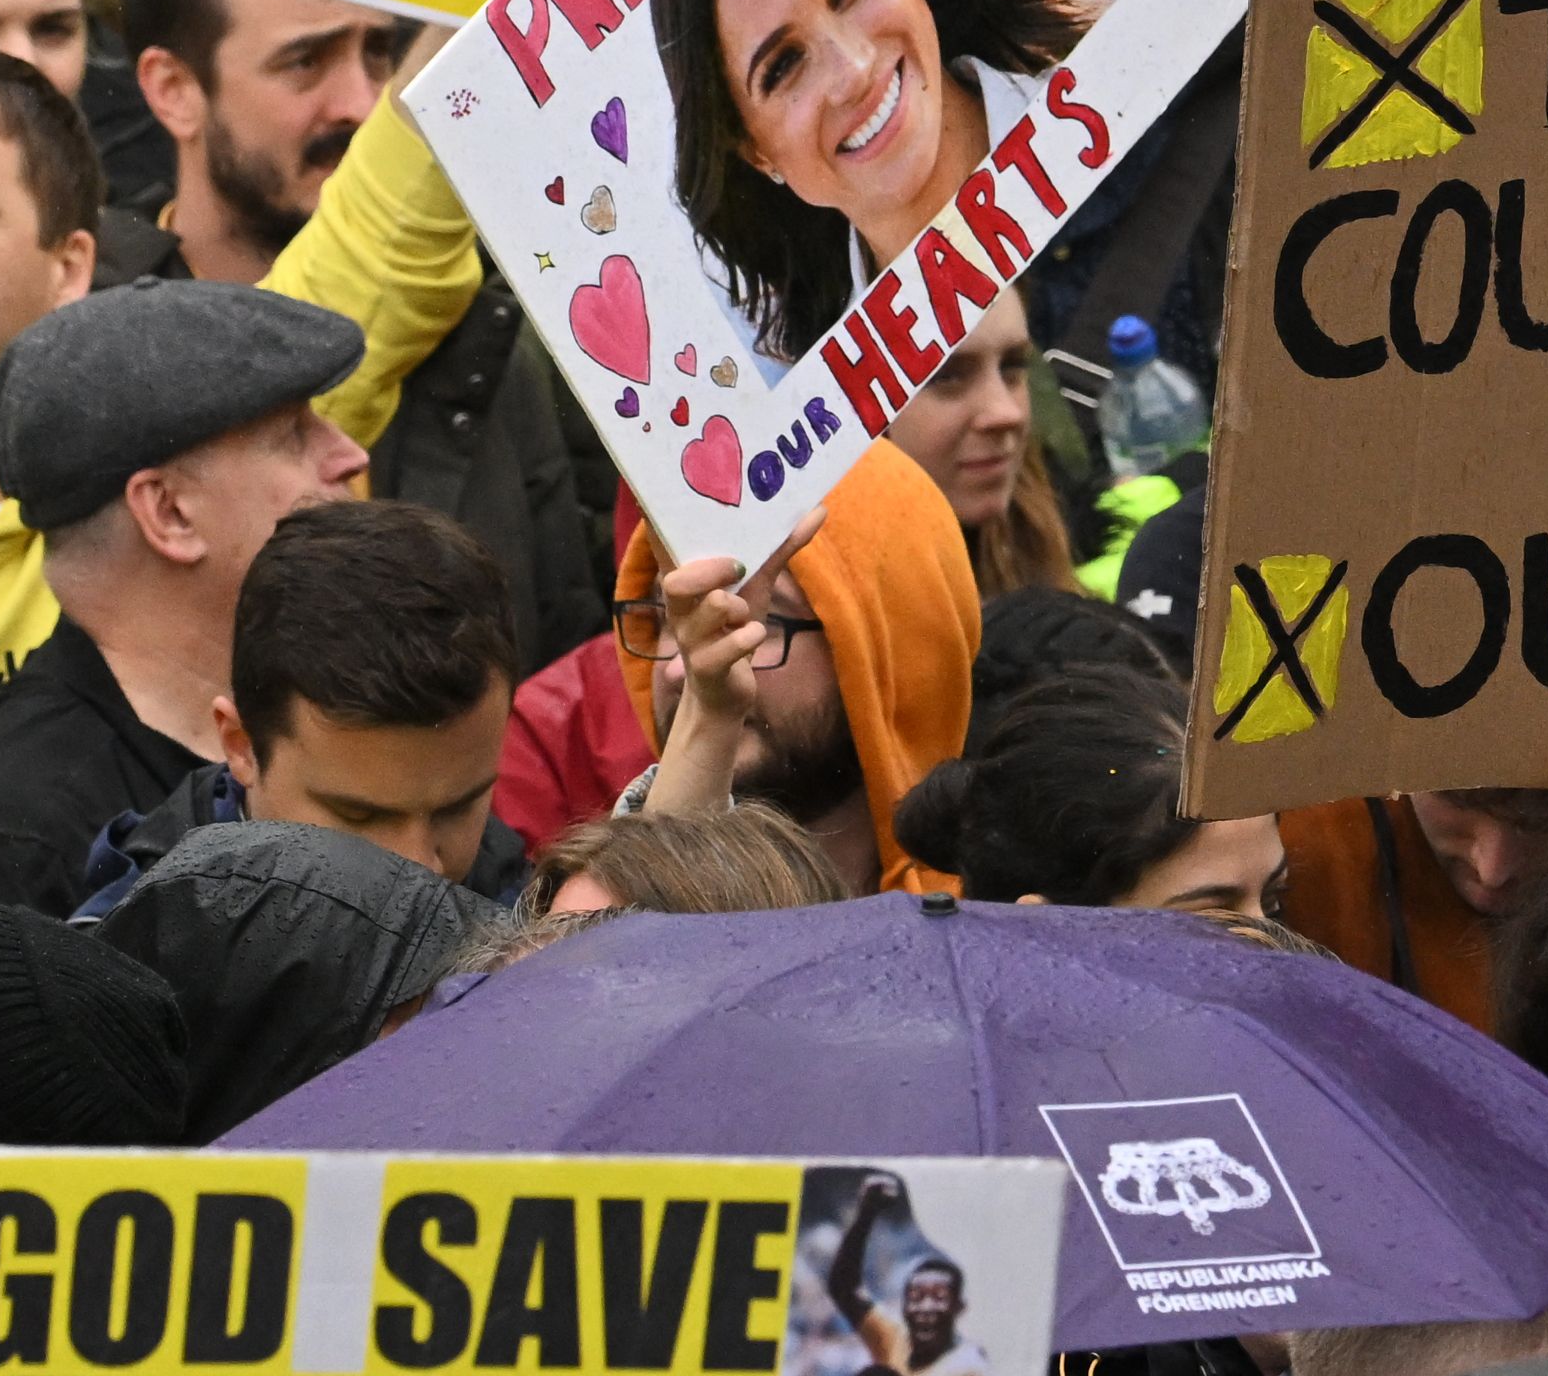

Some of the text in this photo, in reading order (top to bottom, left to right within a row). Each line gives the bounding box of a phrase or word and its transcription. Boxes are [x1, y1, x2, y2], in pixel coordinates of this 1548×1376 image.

[746, 66, 1111, 502] OUR HEARTS
[373, 1190, 792, 1373] SAVE
[1125, 1259, 1332, 1292] REPUBLIKANSKA
[1136, 1284, 1298, 1314] FÖRENINGEN
